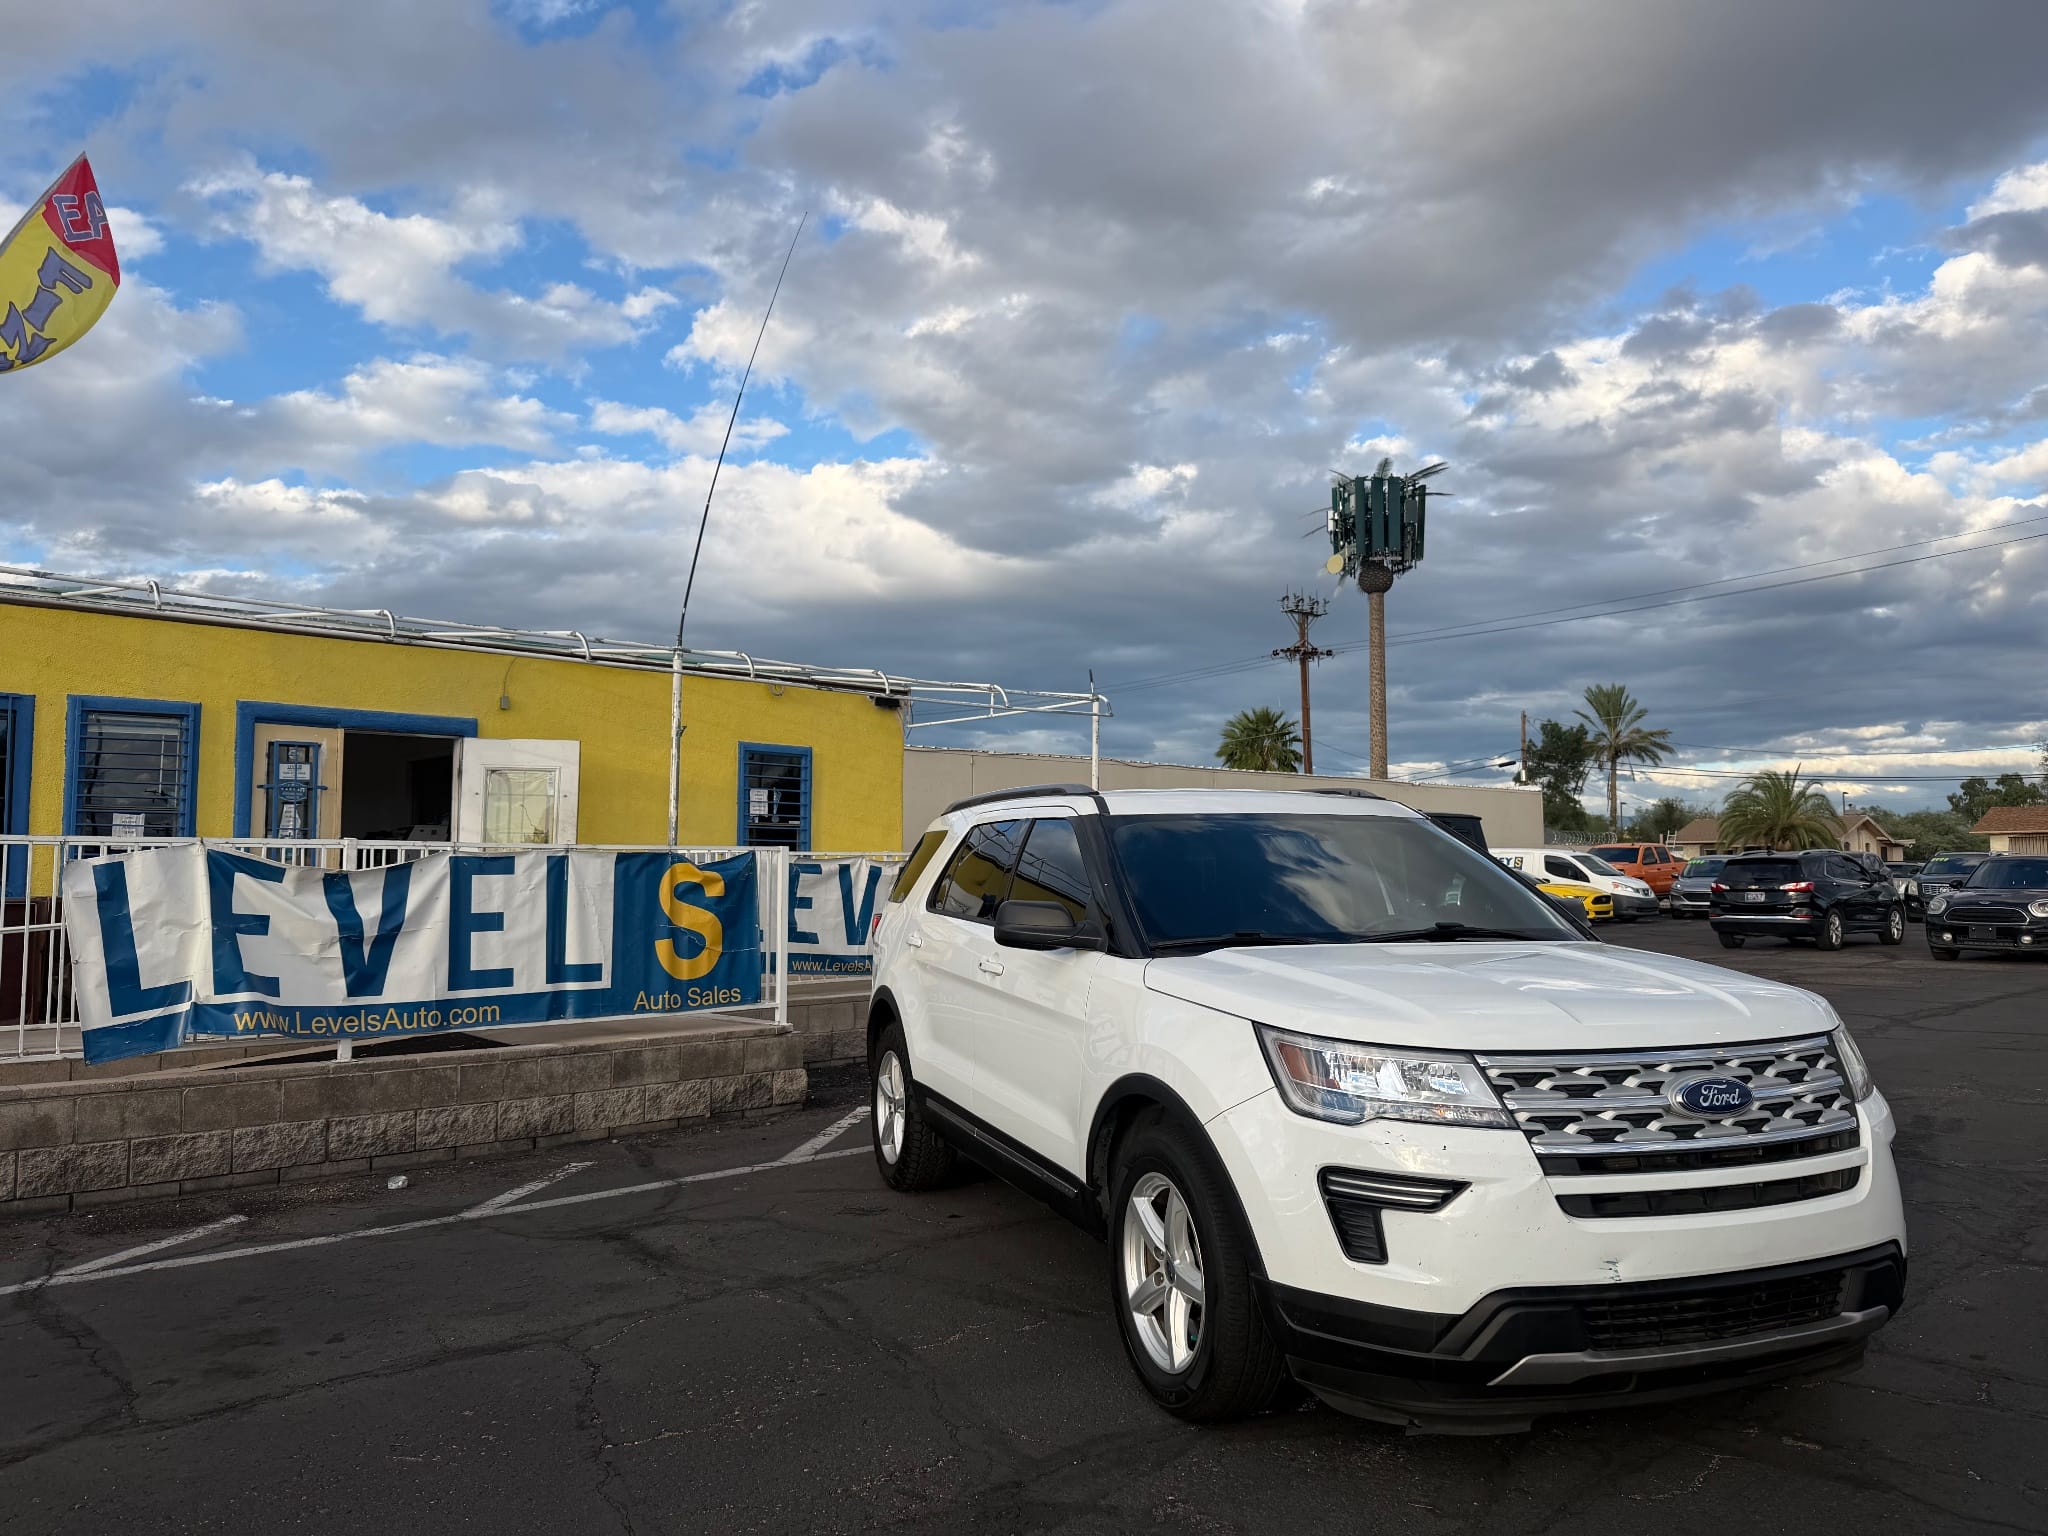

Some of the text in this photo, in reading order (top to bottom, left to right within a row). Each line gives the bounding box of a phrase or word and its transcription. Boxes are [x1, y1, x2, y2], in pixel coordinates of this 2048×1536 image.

[788, 864, 882, 945] EV
[93, 849, 725, 1017] LEVELS
[633, 985, 742, 1011] Auto Sales
[233, 1004, 500, 1034] www.LevelsAuto.com
[1700, 1084, 1741, 1106] Ford
